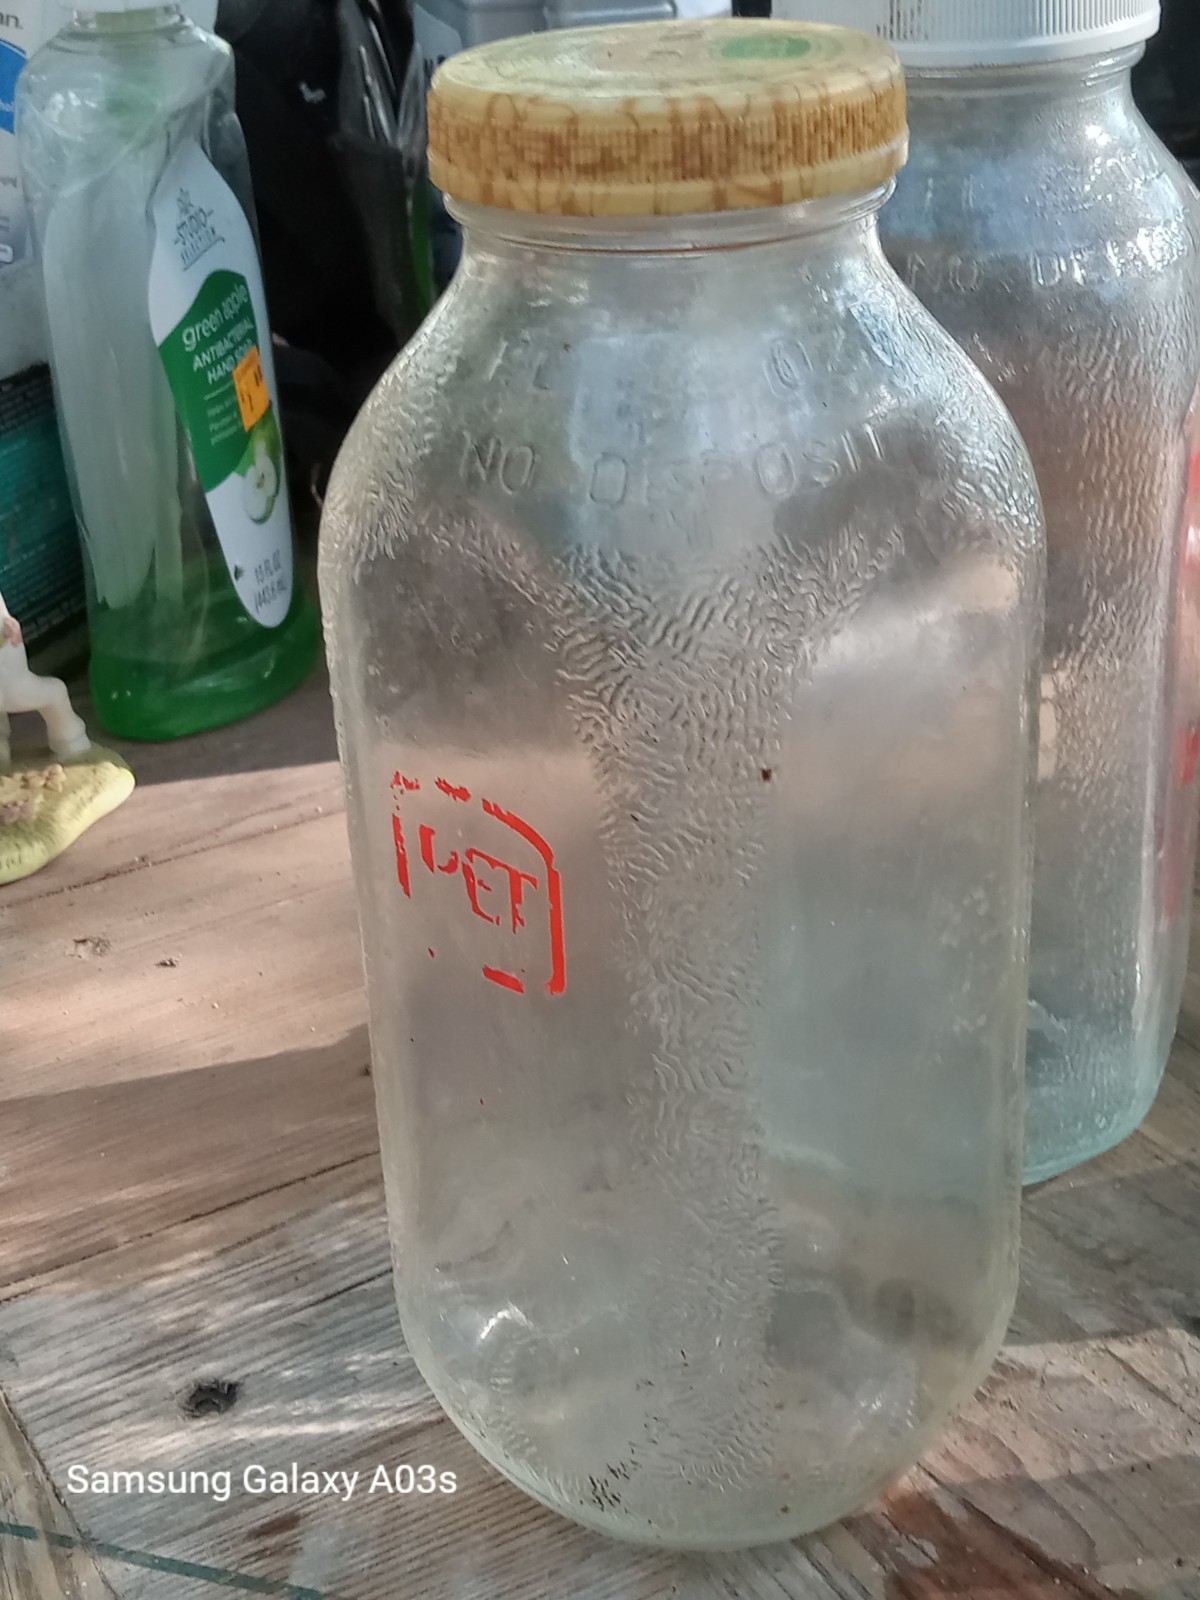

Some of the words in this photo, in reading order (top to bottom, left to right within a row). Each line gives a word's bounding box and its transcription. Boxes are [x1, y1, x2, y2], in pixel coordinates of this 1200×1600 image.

[182, 308, 224, 351] green
[222, 283, 249, 321] apple
[207, 356, 235, 385] HAND
[459, 430, 541, 495] NO
